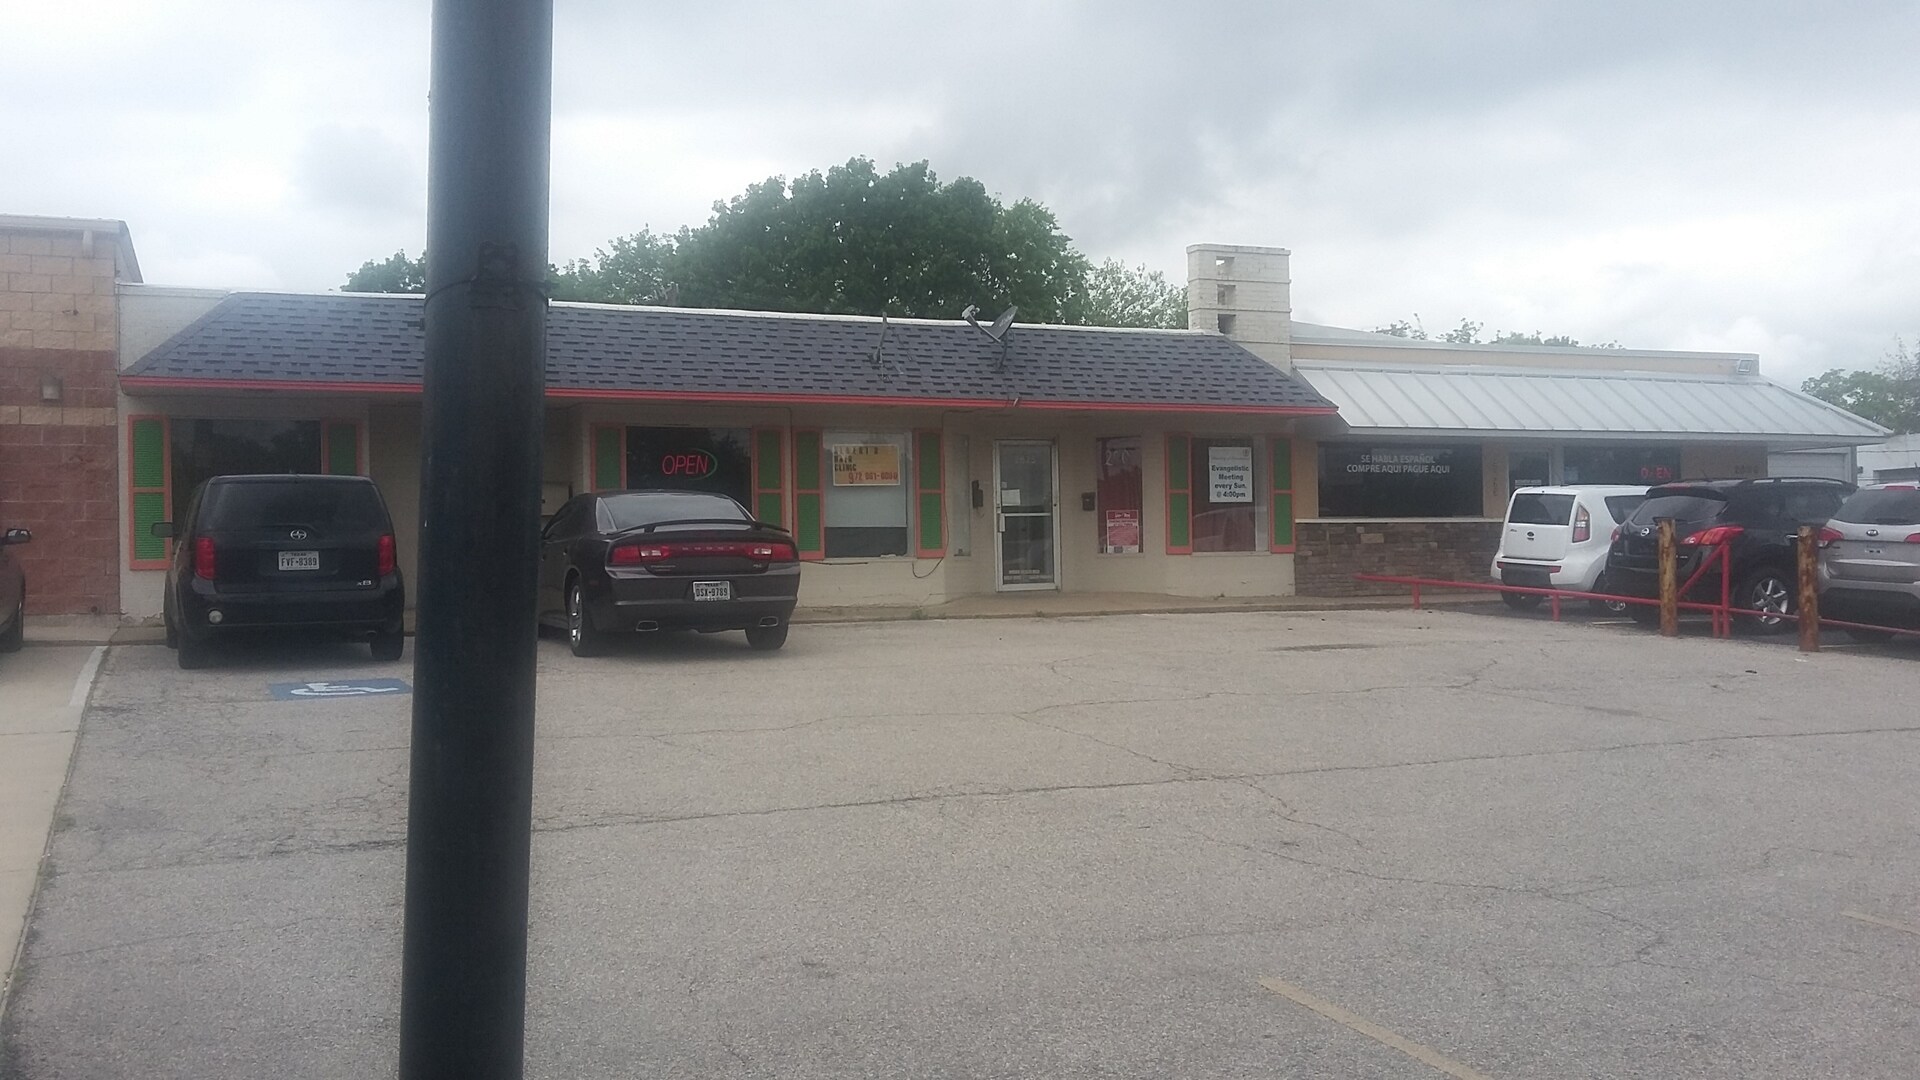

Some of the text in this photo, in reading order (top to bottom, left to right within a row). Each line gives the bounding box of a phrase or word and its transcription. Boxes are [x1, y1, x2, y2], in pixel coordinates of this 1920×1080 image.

[1361, 453, 1436, 464] SE HABLA ESPAÑOL
[662, 455, 708, 475] OPEN
[834, 464, 856, 472] CLINIC
[1211, 465, 1249, 473] Evangelistic
[1346, 464, 1450, 474] COMPRE AQUI PAGUE AQUI
[1223, 491, 1246, 499] 4:00pm
